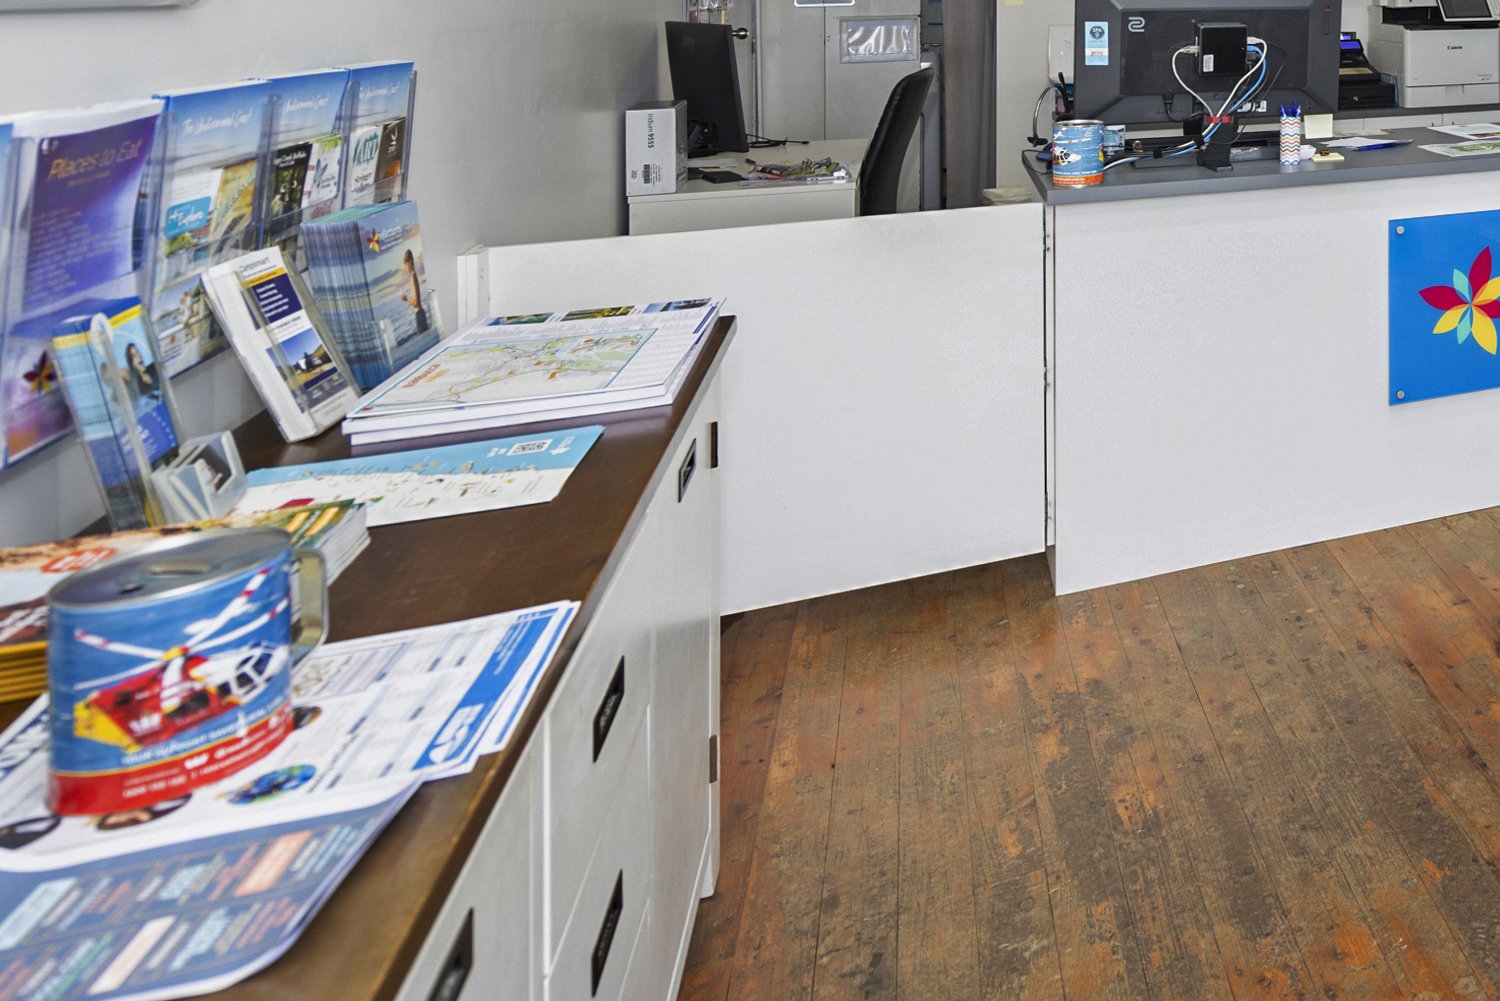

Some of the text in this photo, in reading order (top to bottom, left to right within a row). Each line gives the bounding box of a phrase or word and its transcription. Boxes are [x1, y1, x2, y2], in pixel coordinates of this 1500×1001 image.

[47, 140, 143, 181] Places to Eat
